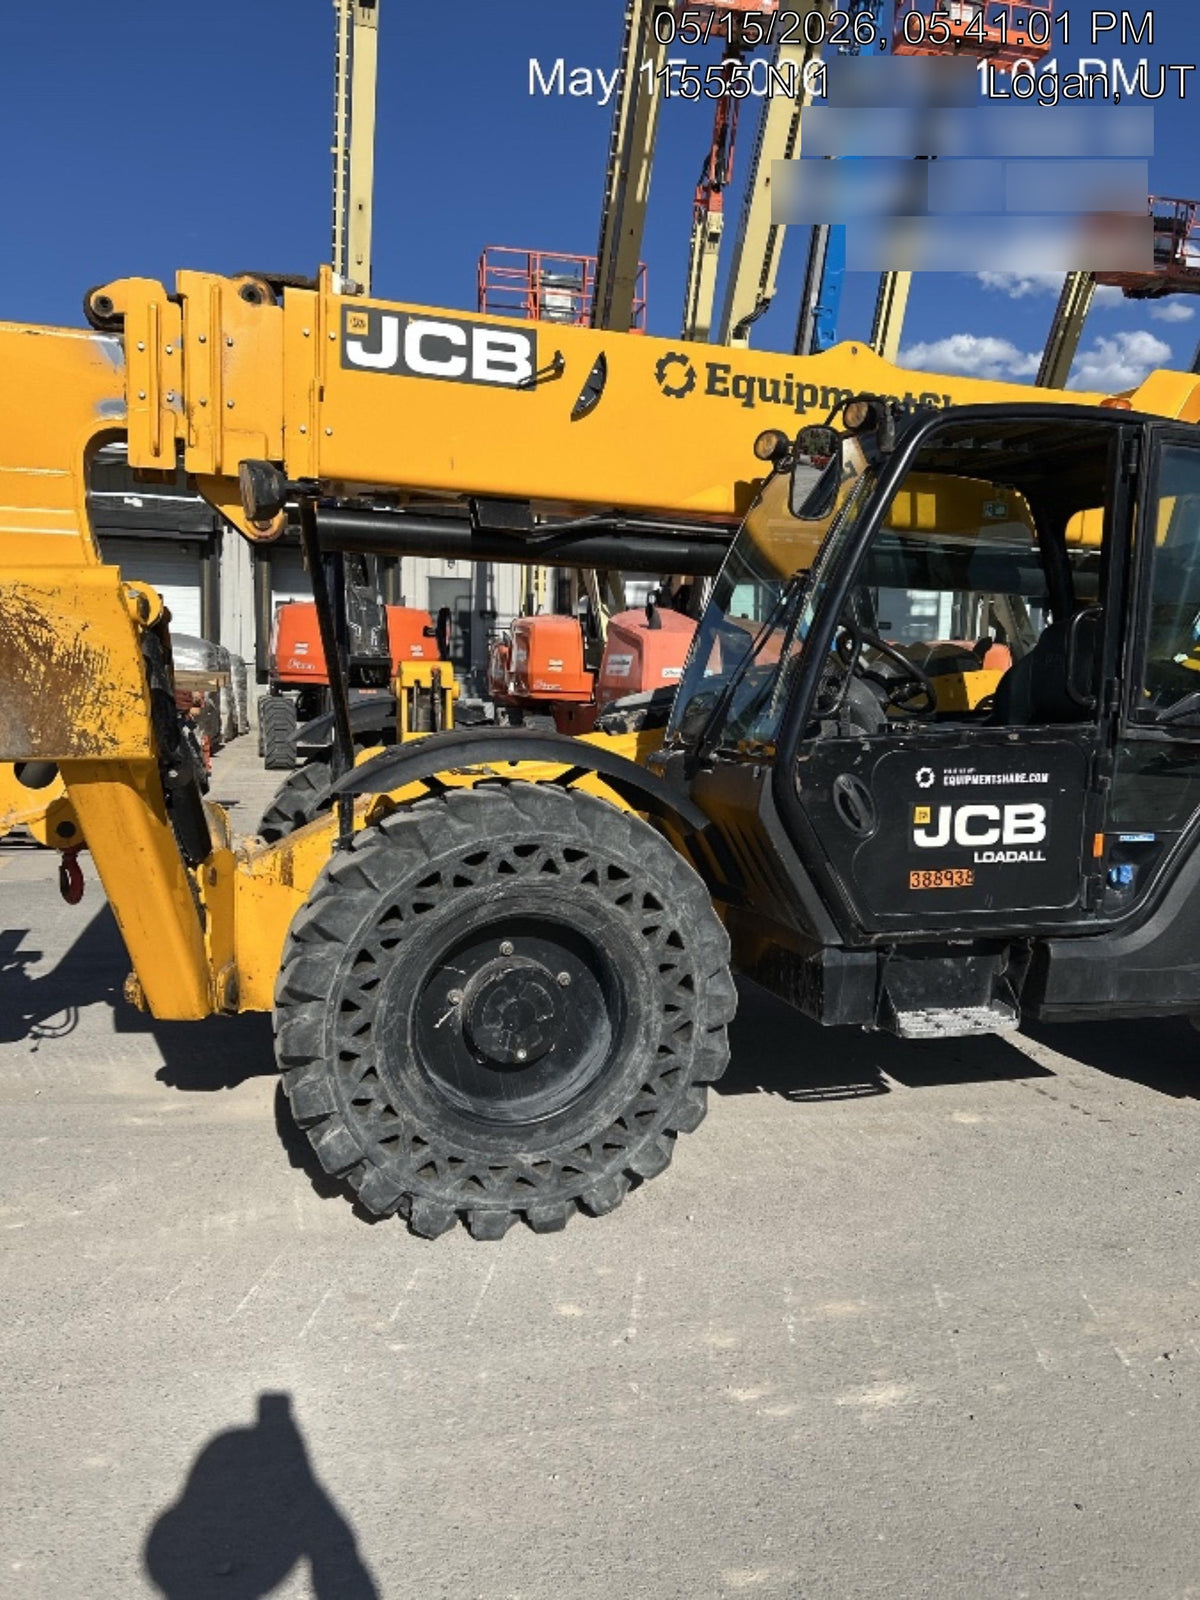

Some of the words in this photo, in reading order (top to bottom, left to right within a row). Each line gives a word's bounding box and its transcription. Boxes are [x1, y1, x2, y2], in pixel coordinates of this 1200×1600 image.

[345, 315, 533, 385] JCB
[943, 772, 1049, 787] EQUIPMENTSHARE.COM
[913, 803, 1047, 848] JCB
[973, 850, 1047, 863] LOADALL
